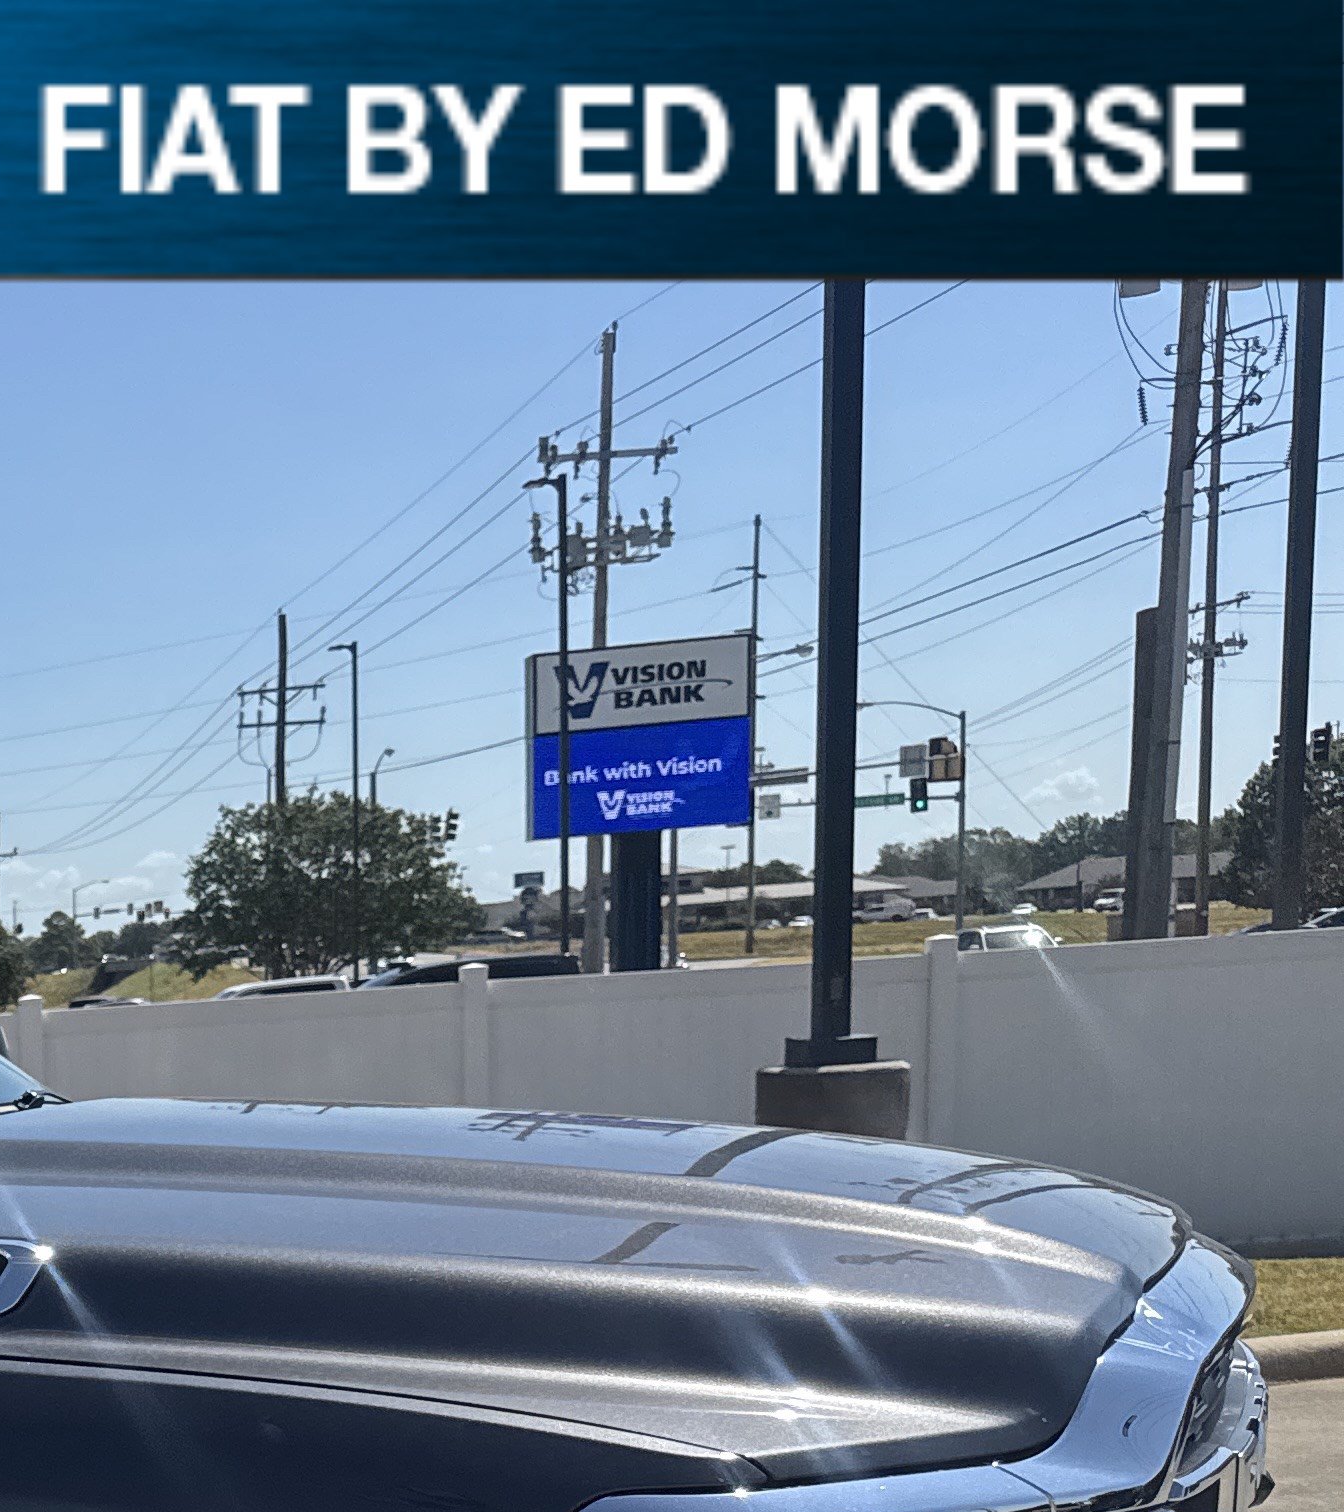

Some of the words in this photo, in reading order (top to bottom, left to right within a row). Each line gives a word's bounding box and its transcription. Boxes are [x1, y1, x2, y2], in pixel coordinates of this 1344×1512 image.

[611, 659, 707, 686] VISION
[614, 683, 705, 710] BANK
[603, 760, 652, 781] with
[656, 755, 722, 777] Vision
